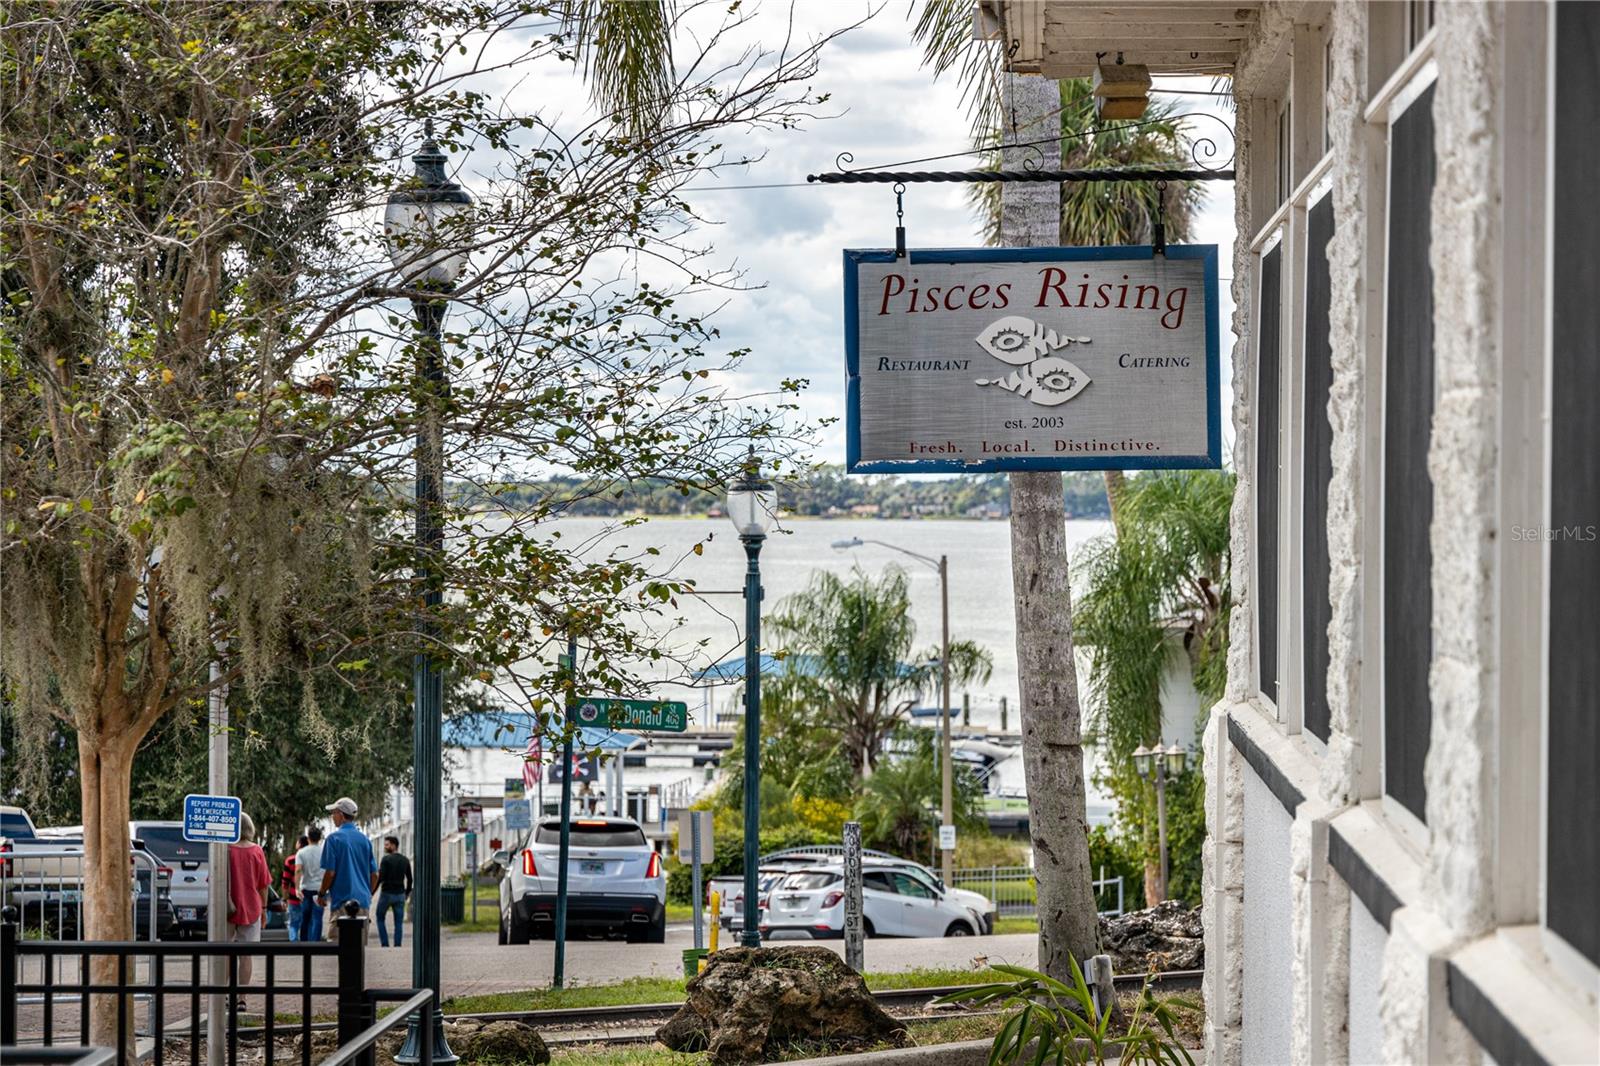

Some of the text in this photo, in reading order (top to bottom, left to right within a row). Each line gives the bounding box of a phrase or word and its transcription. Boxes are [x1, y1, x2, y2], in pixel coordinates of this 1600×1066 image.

[877, 267, 1188, 330] Pisces Rising
[877, 356, 971, 372] RESTAURANT
[1118, 353, 1191, 369] CATERING
[1004, 416, 1064, 429] est. 2003
[909, 438, 1160, 454] Fresh. Local. Distinctive.
[599, 703, 605, 713] N
[608, 704, 663, 726] Donald
[202, 808, 233, 816] EMERGENCY
[211, 801, 235, 809] PROBLEM
[846, 916, 859, 927] ST
